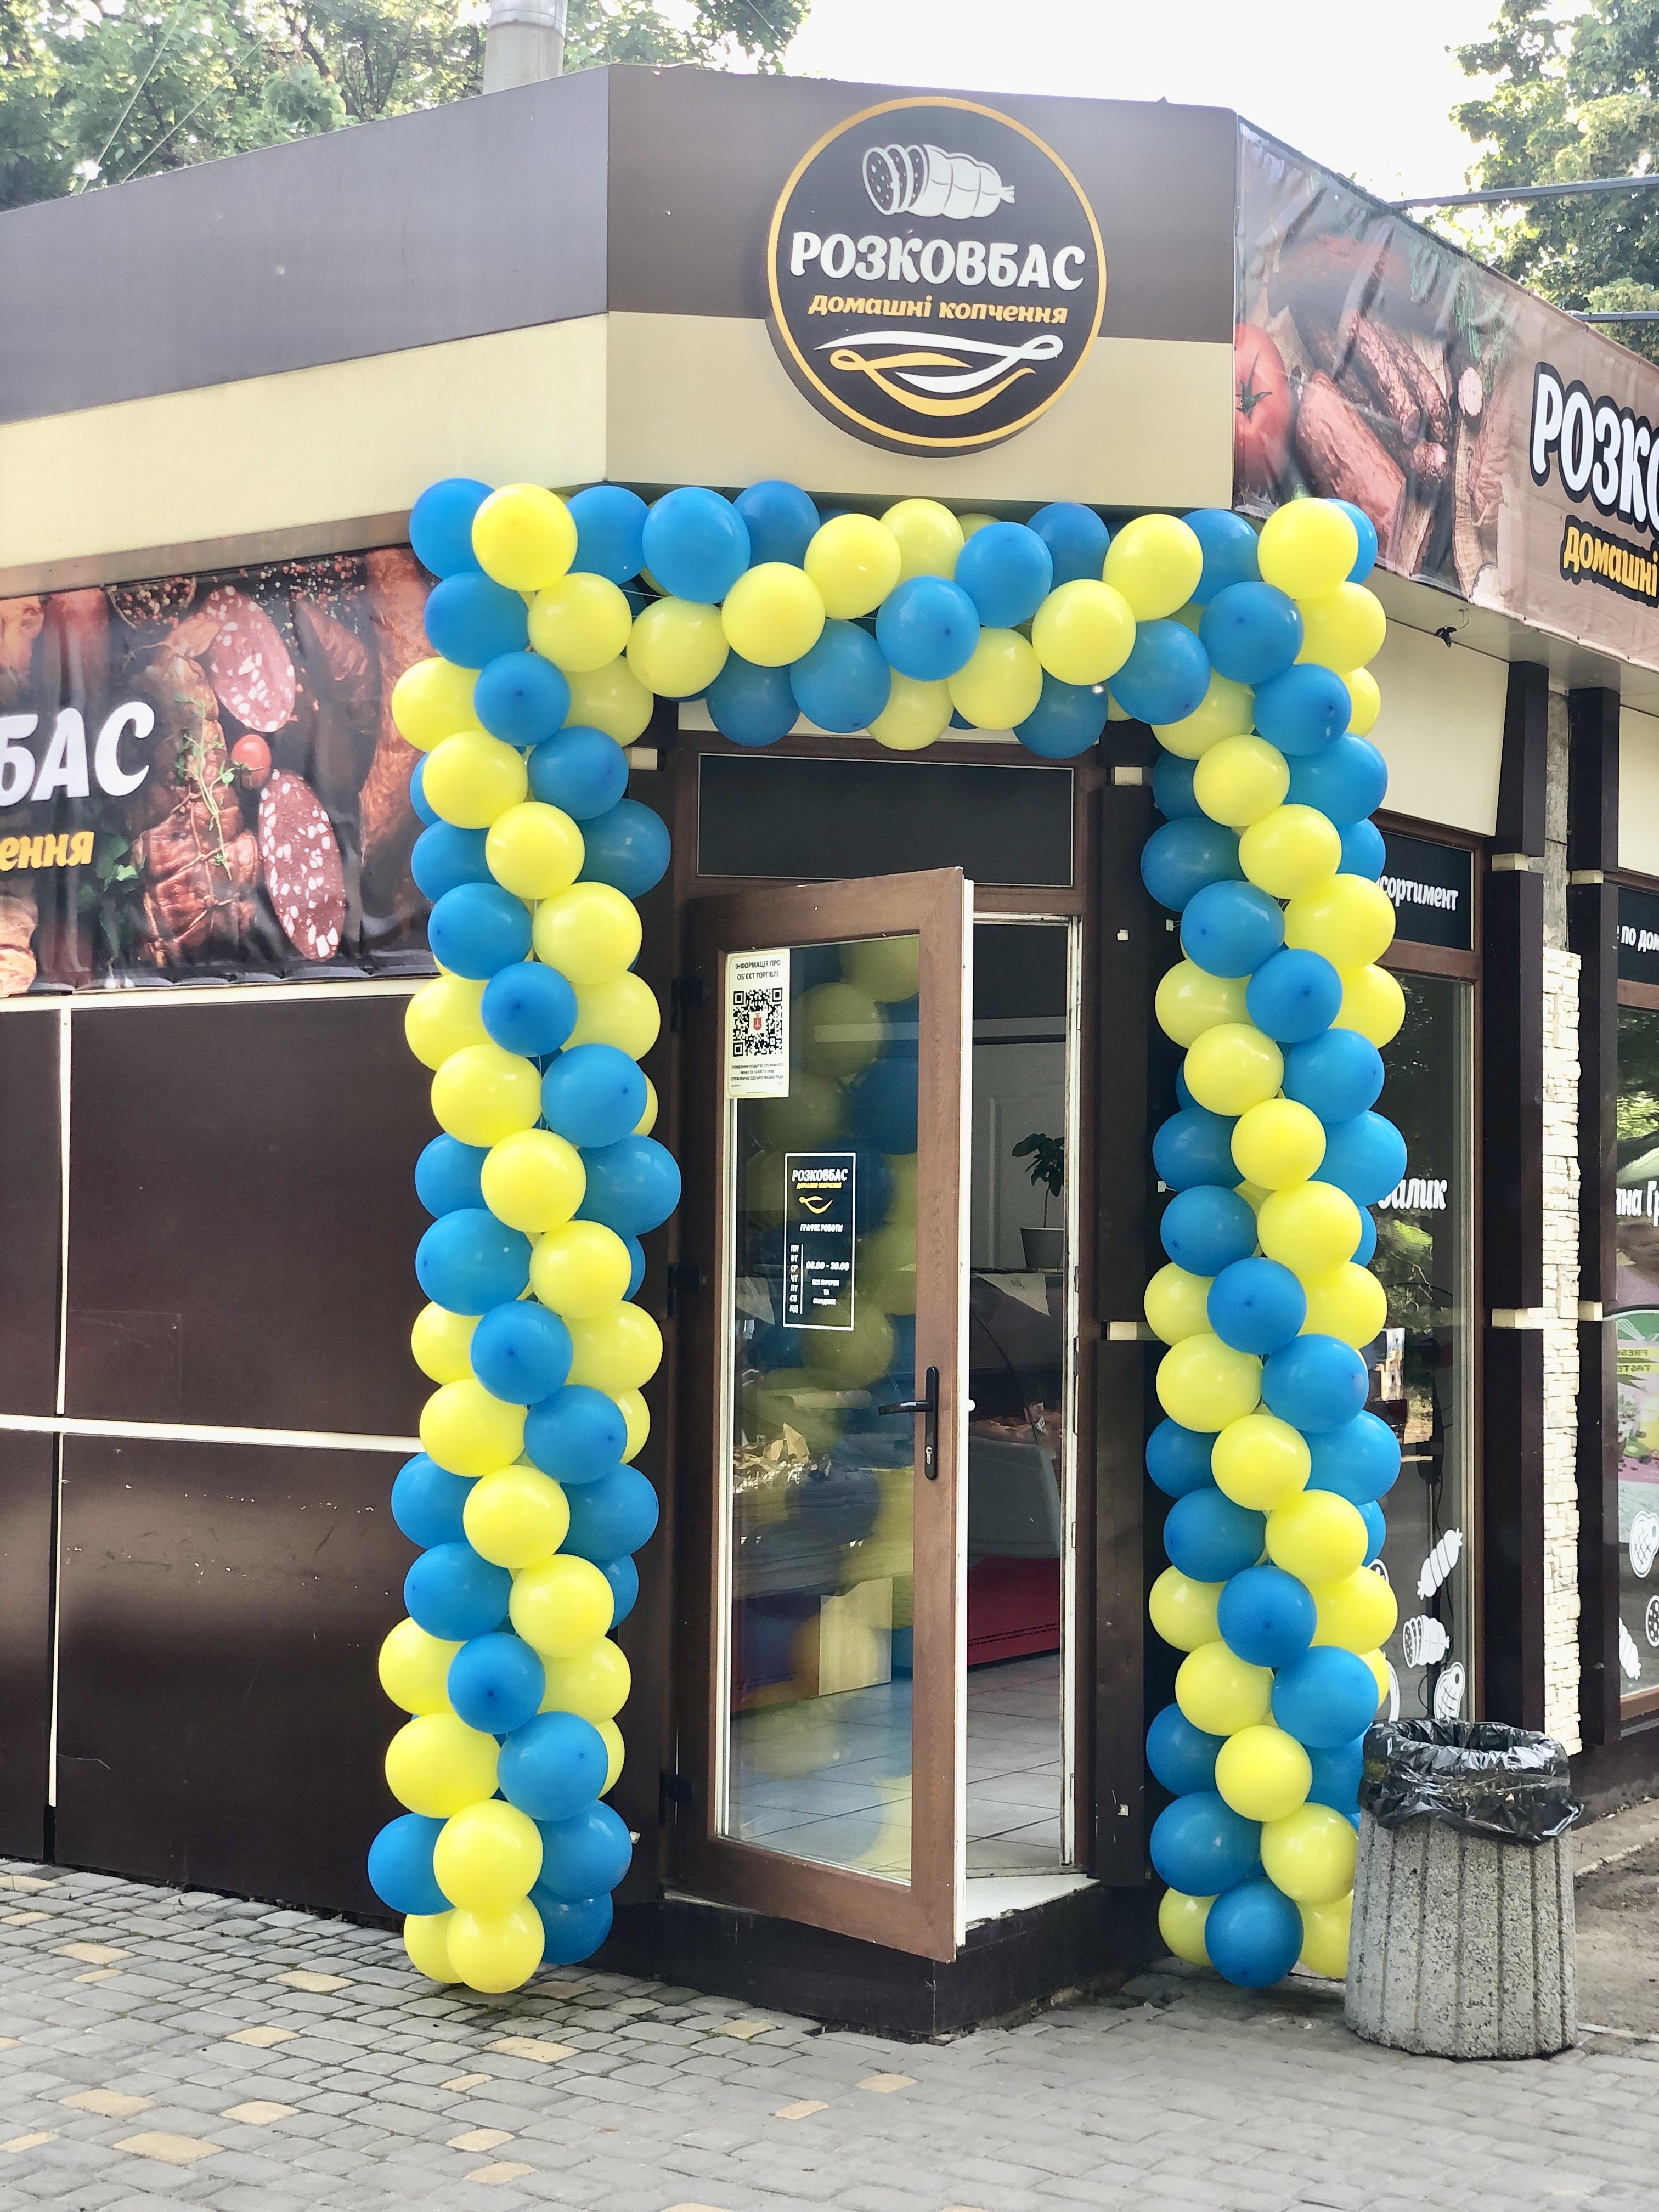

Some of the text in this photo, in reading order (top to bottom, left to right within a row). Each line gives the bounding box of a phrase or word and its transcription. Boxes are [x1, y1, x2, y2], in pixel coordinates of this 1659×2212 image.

[790, 231, 1085, 291] РОЗКОВБАС
[808, 295, 1068, 324] домашні копчення
[1563, 526, 1658, 597] домашні
[0, 701, 155, 806] БАС
[1376, 875, 1459, 911] сортимент
[1621, 926, 1637, 946] по
[735, 960, 769, 969] ІНФОРМАЦІЯ
[756, 970, 778, 979] ТОРГІВЛІ
[792, 1168, 848, 1182] РОЗКОВБАС
[1378, 1178, 1447, 1210] алик
